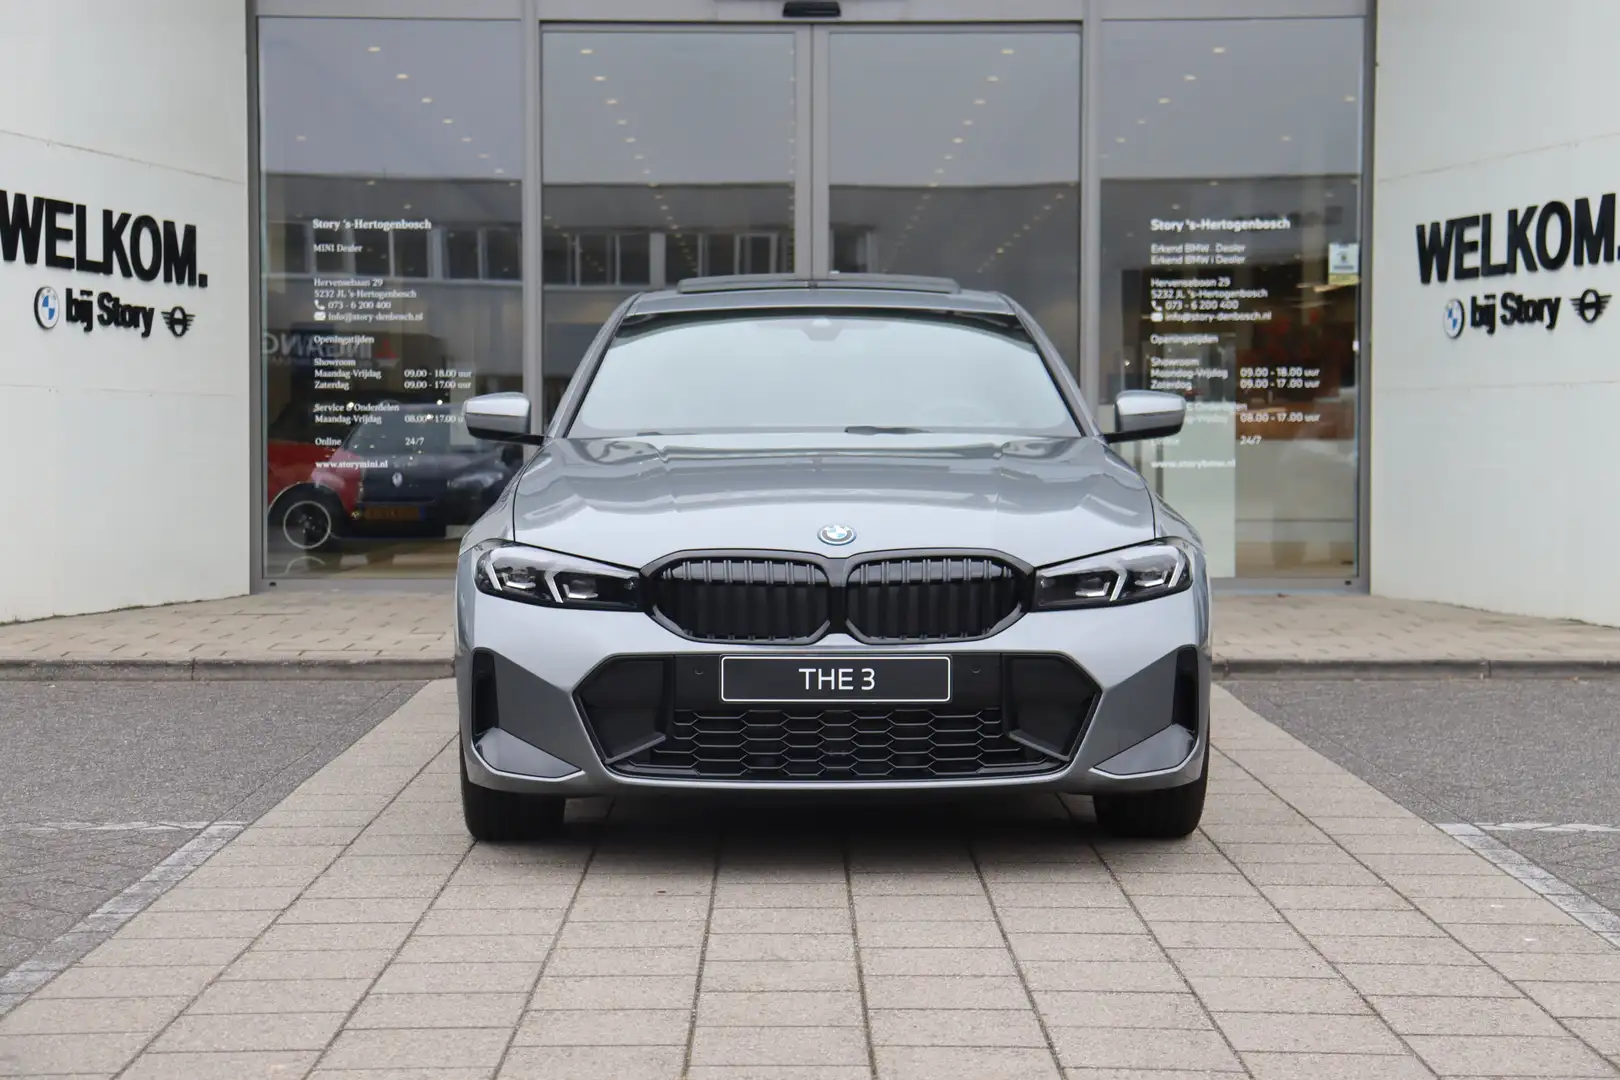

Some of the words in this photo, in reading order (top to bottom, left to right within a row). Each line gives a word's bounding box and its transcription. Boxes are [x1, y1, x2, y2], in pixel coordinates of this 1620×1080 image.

[313, 218, 340, 231] Story
[1150, 218, 1184, 232] Story
[1186, 218, 1290, 232] 's-Hertogenbosch
[0, 190, 208, 288] WELKOM.
[313, 244, 336, 252] MINI
[337, 244, 363, 252] Dealer
[1150, 244, 1183, 254] Erkend
[1184, 244, 1210, 254] BMW
[1215, 243, 1245, 254] Dealer
[1150, 255, 1183, 264] Erkend
[1184, 255, 1209, 264] BMW
[1215, 254, 1245, 264] Dealer
[372, 278, 384, 287] 29
[1218, 278, 1231, 287] 29
[314, 290, 334, 298] 5232
[1151, 290, 1174, 299] 5232
[328, 301, 343, 309] 073
[350, 301, 357, 309] 6
[358, 301, 373, 309] 200
[375, 301, 391, 309] 400
[1165, 300, 1183, 310] 073
[1190, 300, 1198, 310] 6
[1199, 300, 1218, 310] 200
[1219, 300, 1239, 310] 400
[97, 292, 154, 338] Story
[1500, 292, 1561, 330] Story
[1150, 357, 1199, 366] Showroom
[314, 370, 382, 379] Maandag-Vrijdag
[404, 369, 427, 378] 09.00
[435, 369, 456, 378] 18.00
[1240, 368, 1268, 378] 09.00
[1304, 369, 1320, 377] uur
[315, 381, 350, 390] Zaterdag
[404, 381, 427, 389] 09.00
[434, 381, 456, 389] 17.00
[1150, 380, 1192, 391] Zaterdag
[314, 404, 344, 412] Service
[354, 403, 399, 412] Onderdelen
[315, 415, 382, 424] Maandag-Vrijdag
[435, 415, 456, 423] 17.00
[1304, 414, 1320, 422] uur
[315, 438, 342, 446] Online
[405, 438, 425, 446] 24/7
[1240, 436, 1262, 445] 24/7
[315, 460, 388, 470] www.storymini.nl
[798, 668, 854, 690] THE
[861, 668, 876, 690] 3
